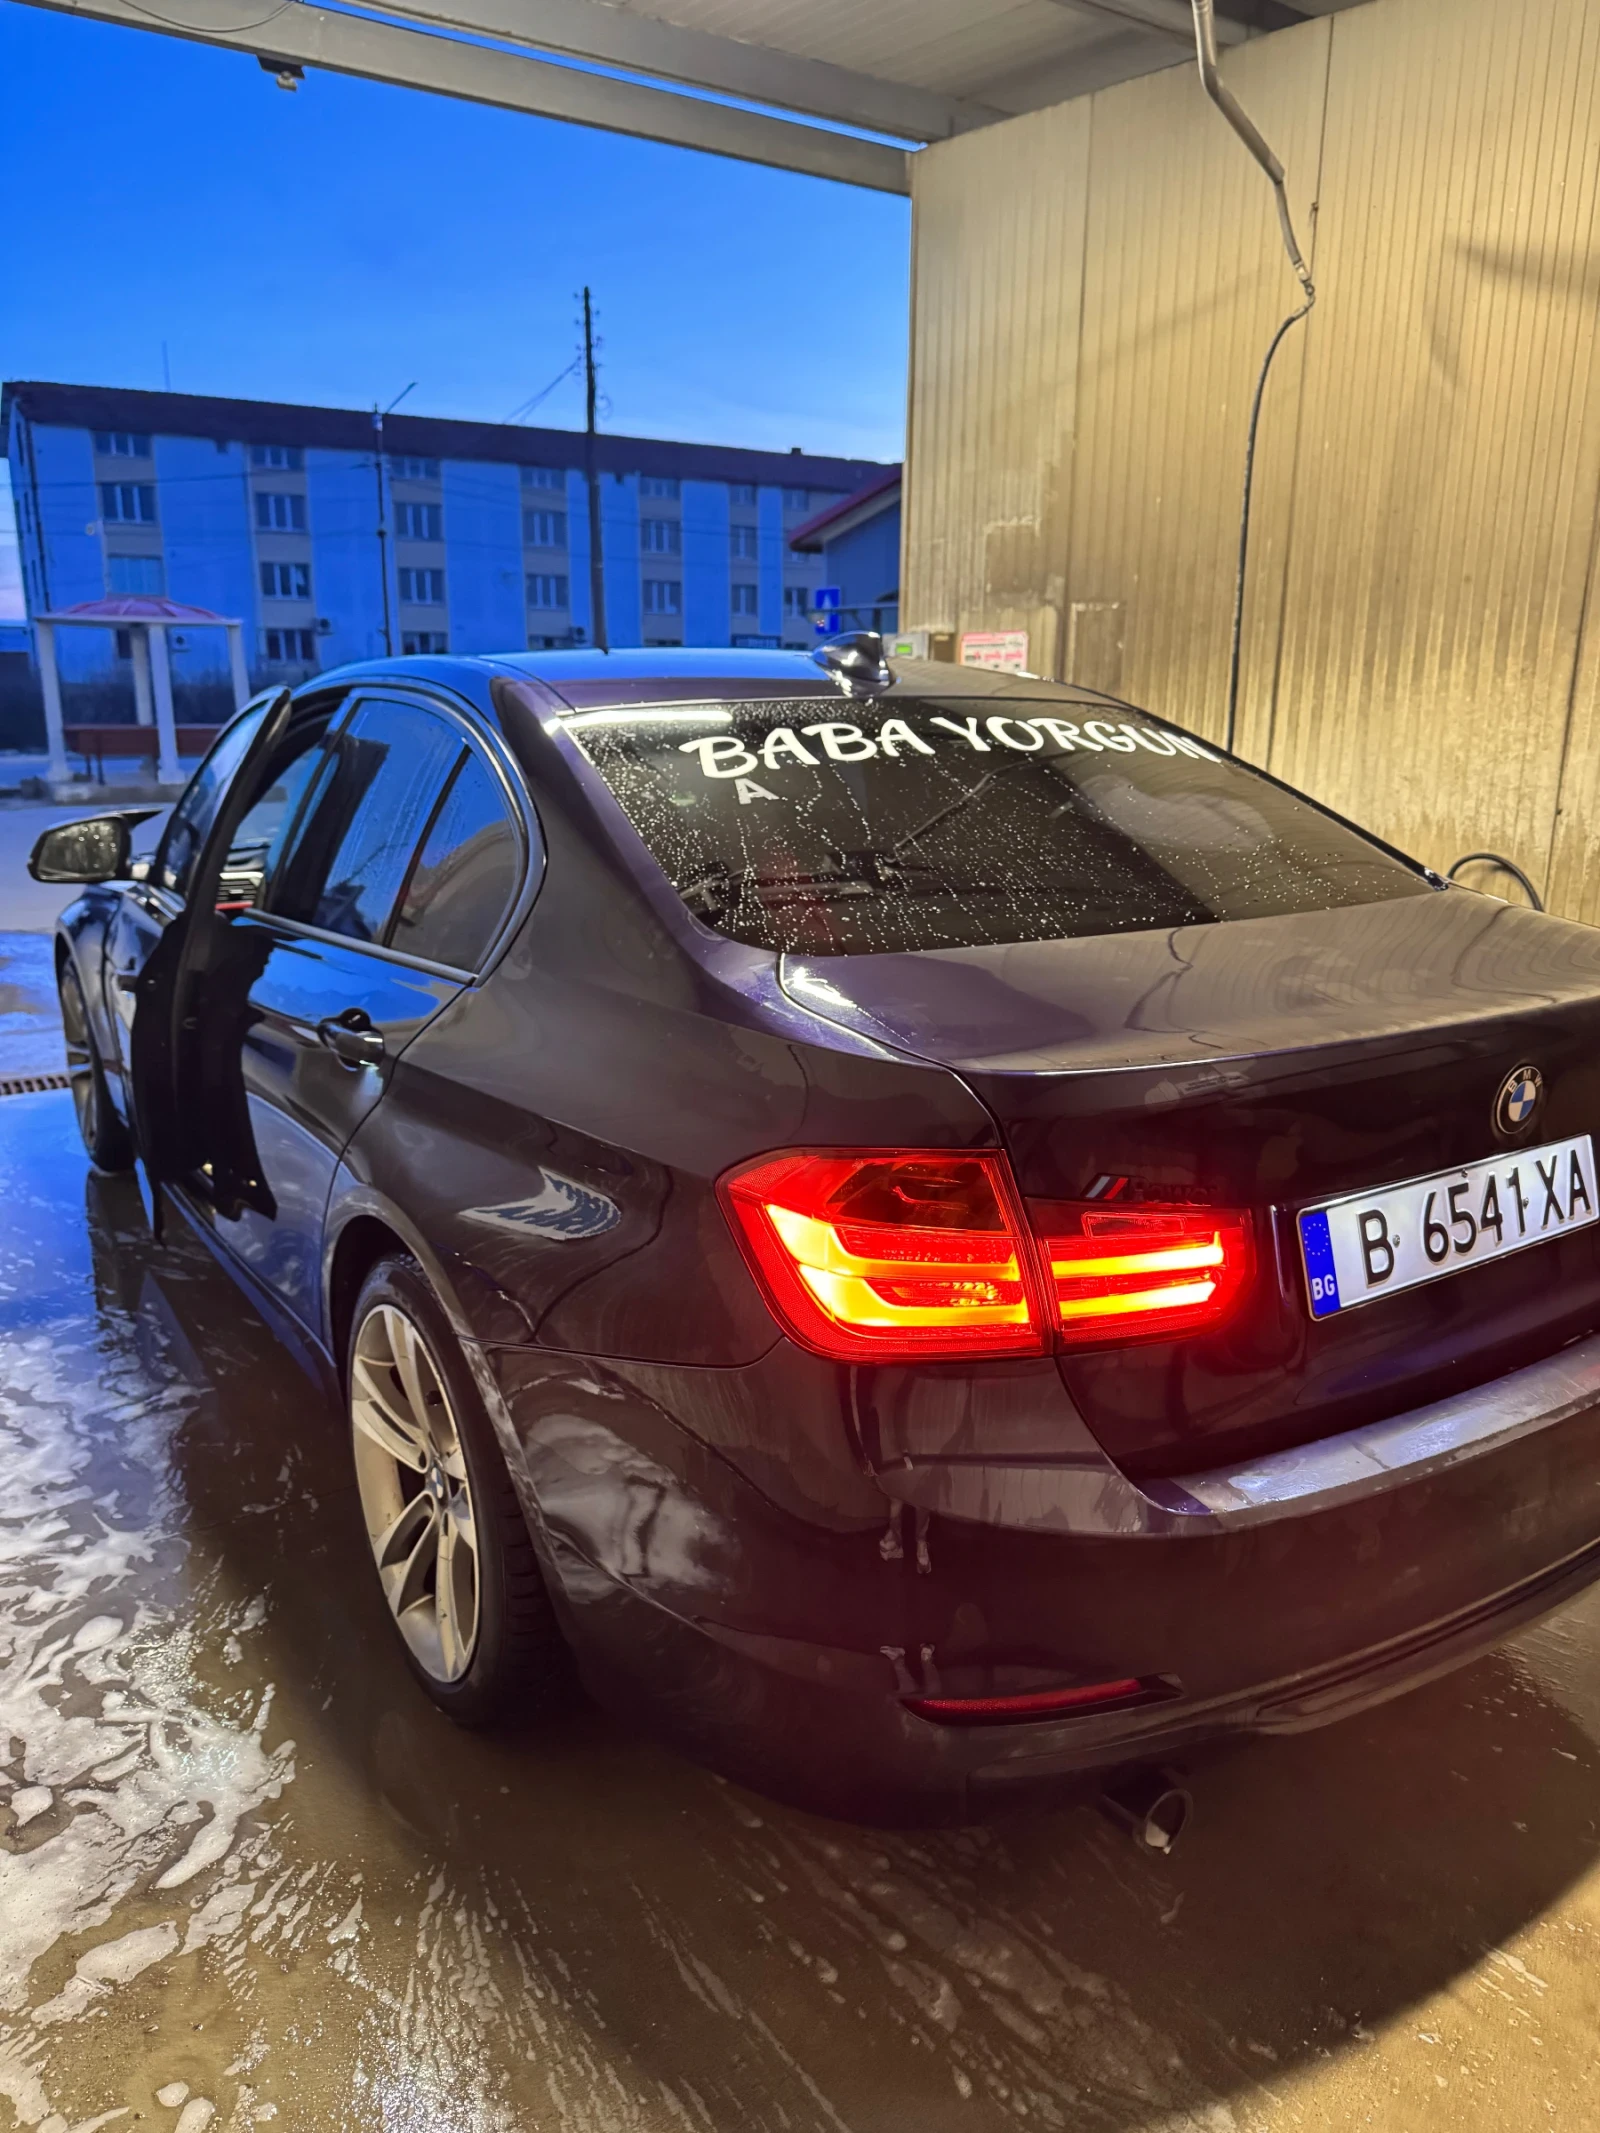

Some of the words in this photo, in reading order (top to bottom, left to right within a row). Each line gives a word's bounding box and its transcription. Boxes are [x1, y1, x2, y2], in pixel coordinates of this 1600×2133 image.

[679, 717, 936, 779] BABA
[930, 716, 1222, 764] YORGUN
[733, 777, 780, 805] A
[1507, 1068, 1543, 1094] BMW
[1356, 1209, 1395, 1288] B
[1422, 1165, 1527, 1265] 6541
[1535, 1149, 1593, 1230] XA
[1311, 1273, 1336, 1300] BG
